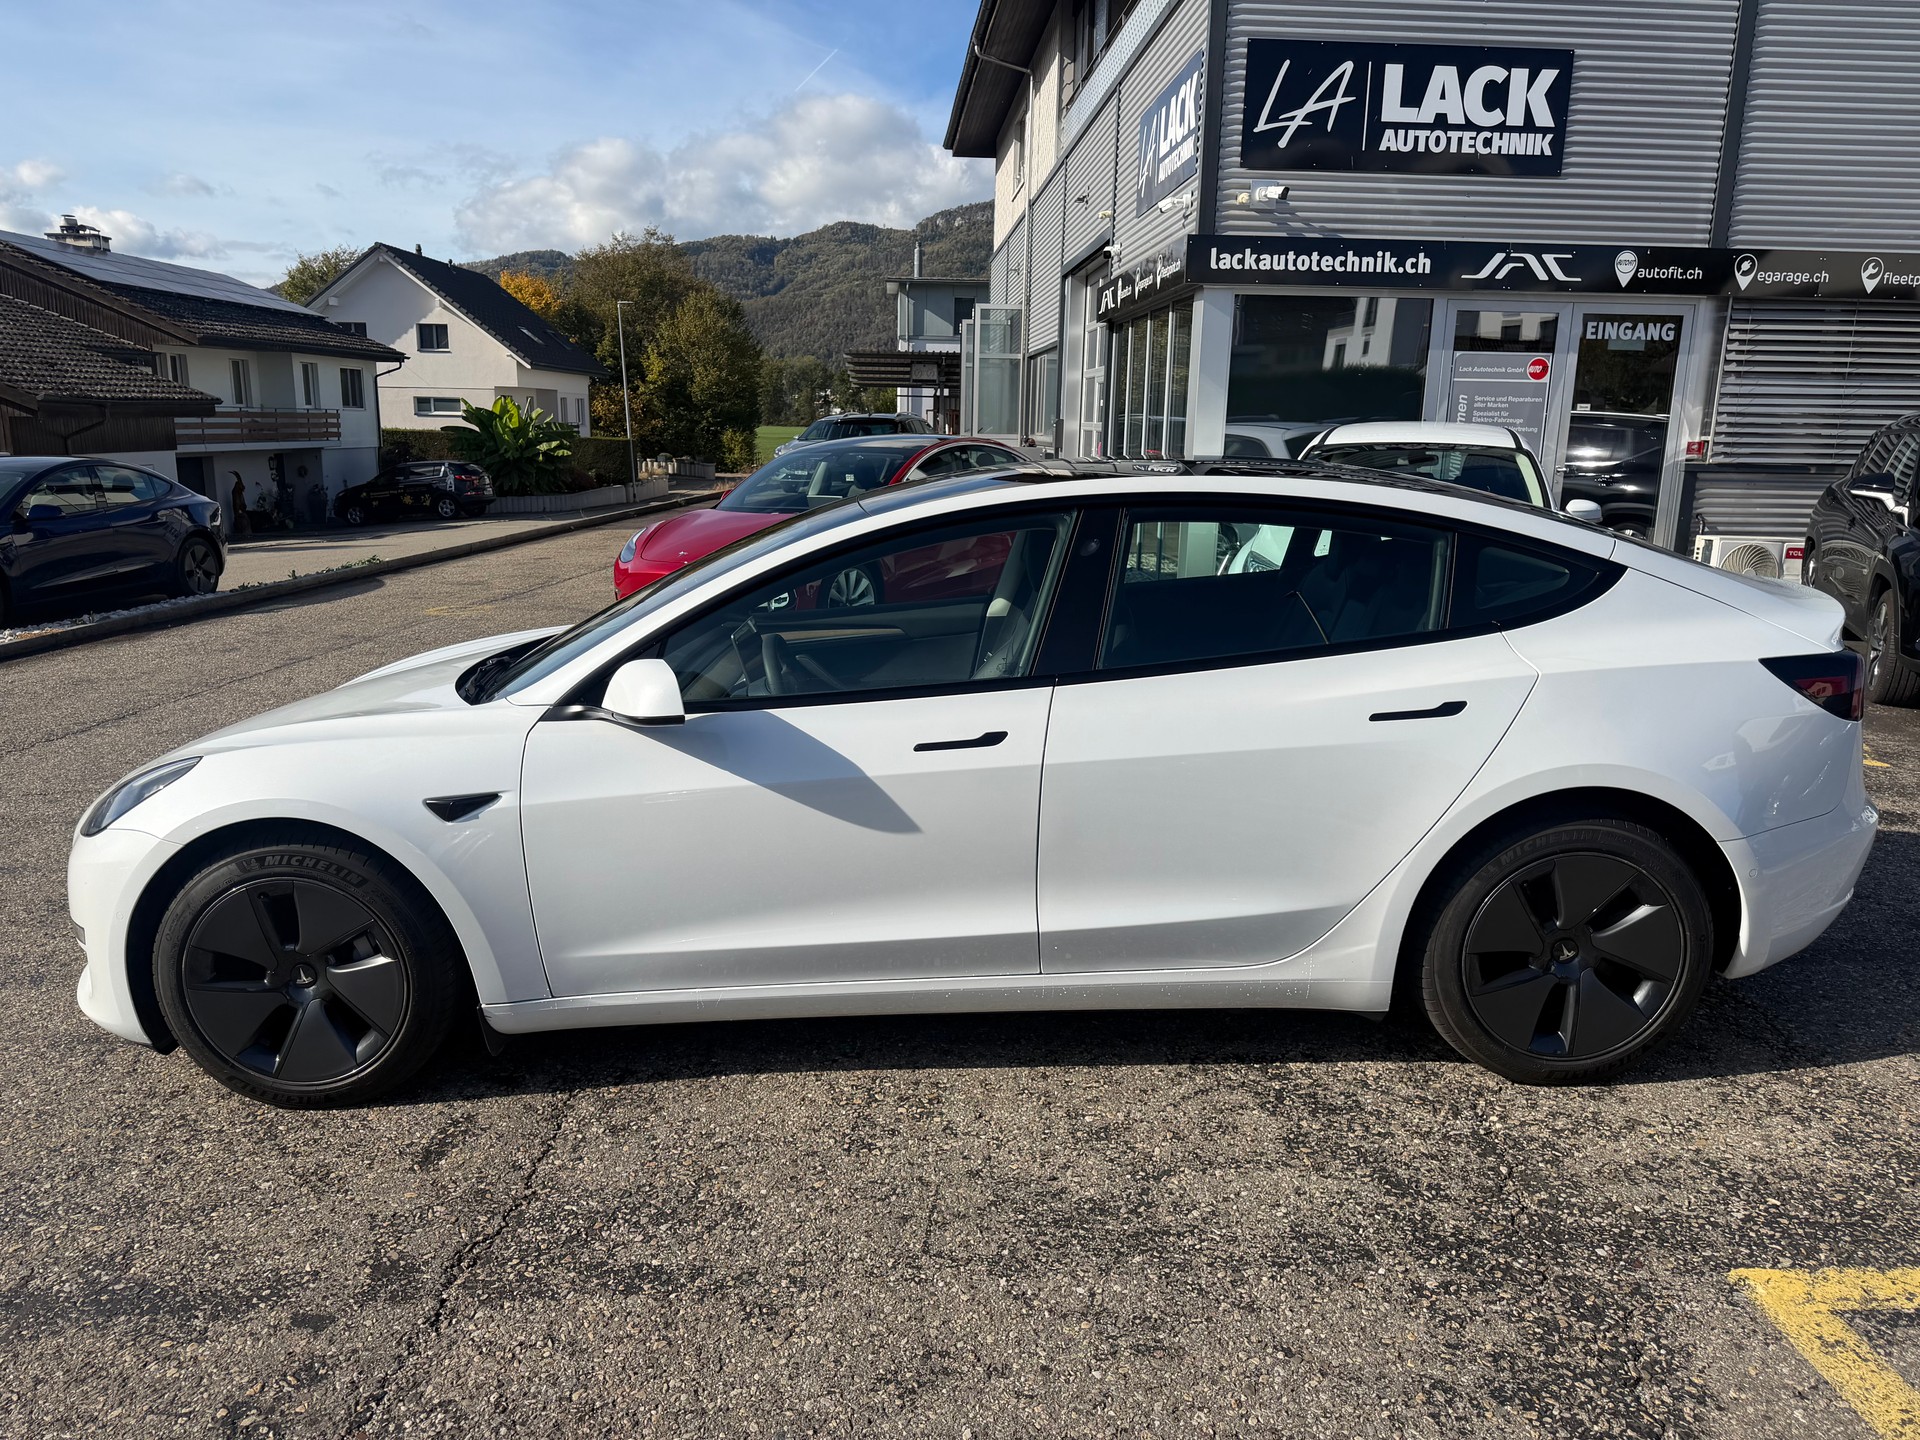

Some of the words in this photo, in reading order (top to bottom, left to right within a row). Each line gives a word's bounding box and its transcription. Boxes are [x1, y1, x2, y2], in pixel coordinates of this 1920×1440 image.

[1159, 70, 1199, 159] LACK
[1253, 59, 1356, 148] LA
[1381, 63, 1560, 128] LACK
[1158, 133, 1196, 184] AUTOTECHNIK
[1379, 128, 1554, 156] AUTOTECHNIK
[1210, 247, 1432, 274] lackautotechnik.ch
[1637, 266, 1703, 280] autofit.ch
[1757, 270, 1830, 285] egarage.ch
[1585, 321, 1676, 341] EINGANG
[264, 854, 365, 887] MICHELIN
